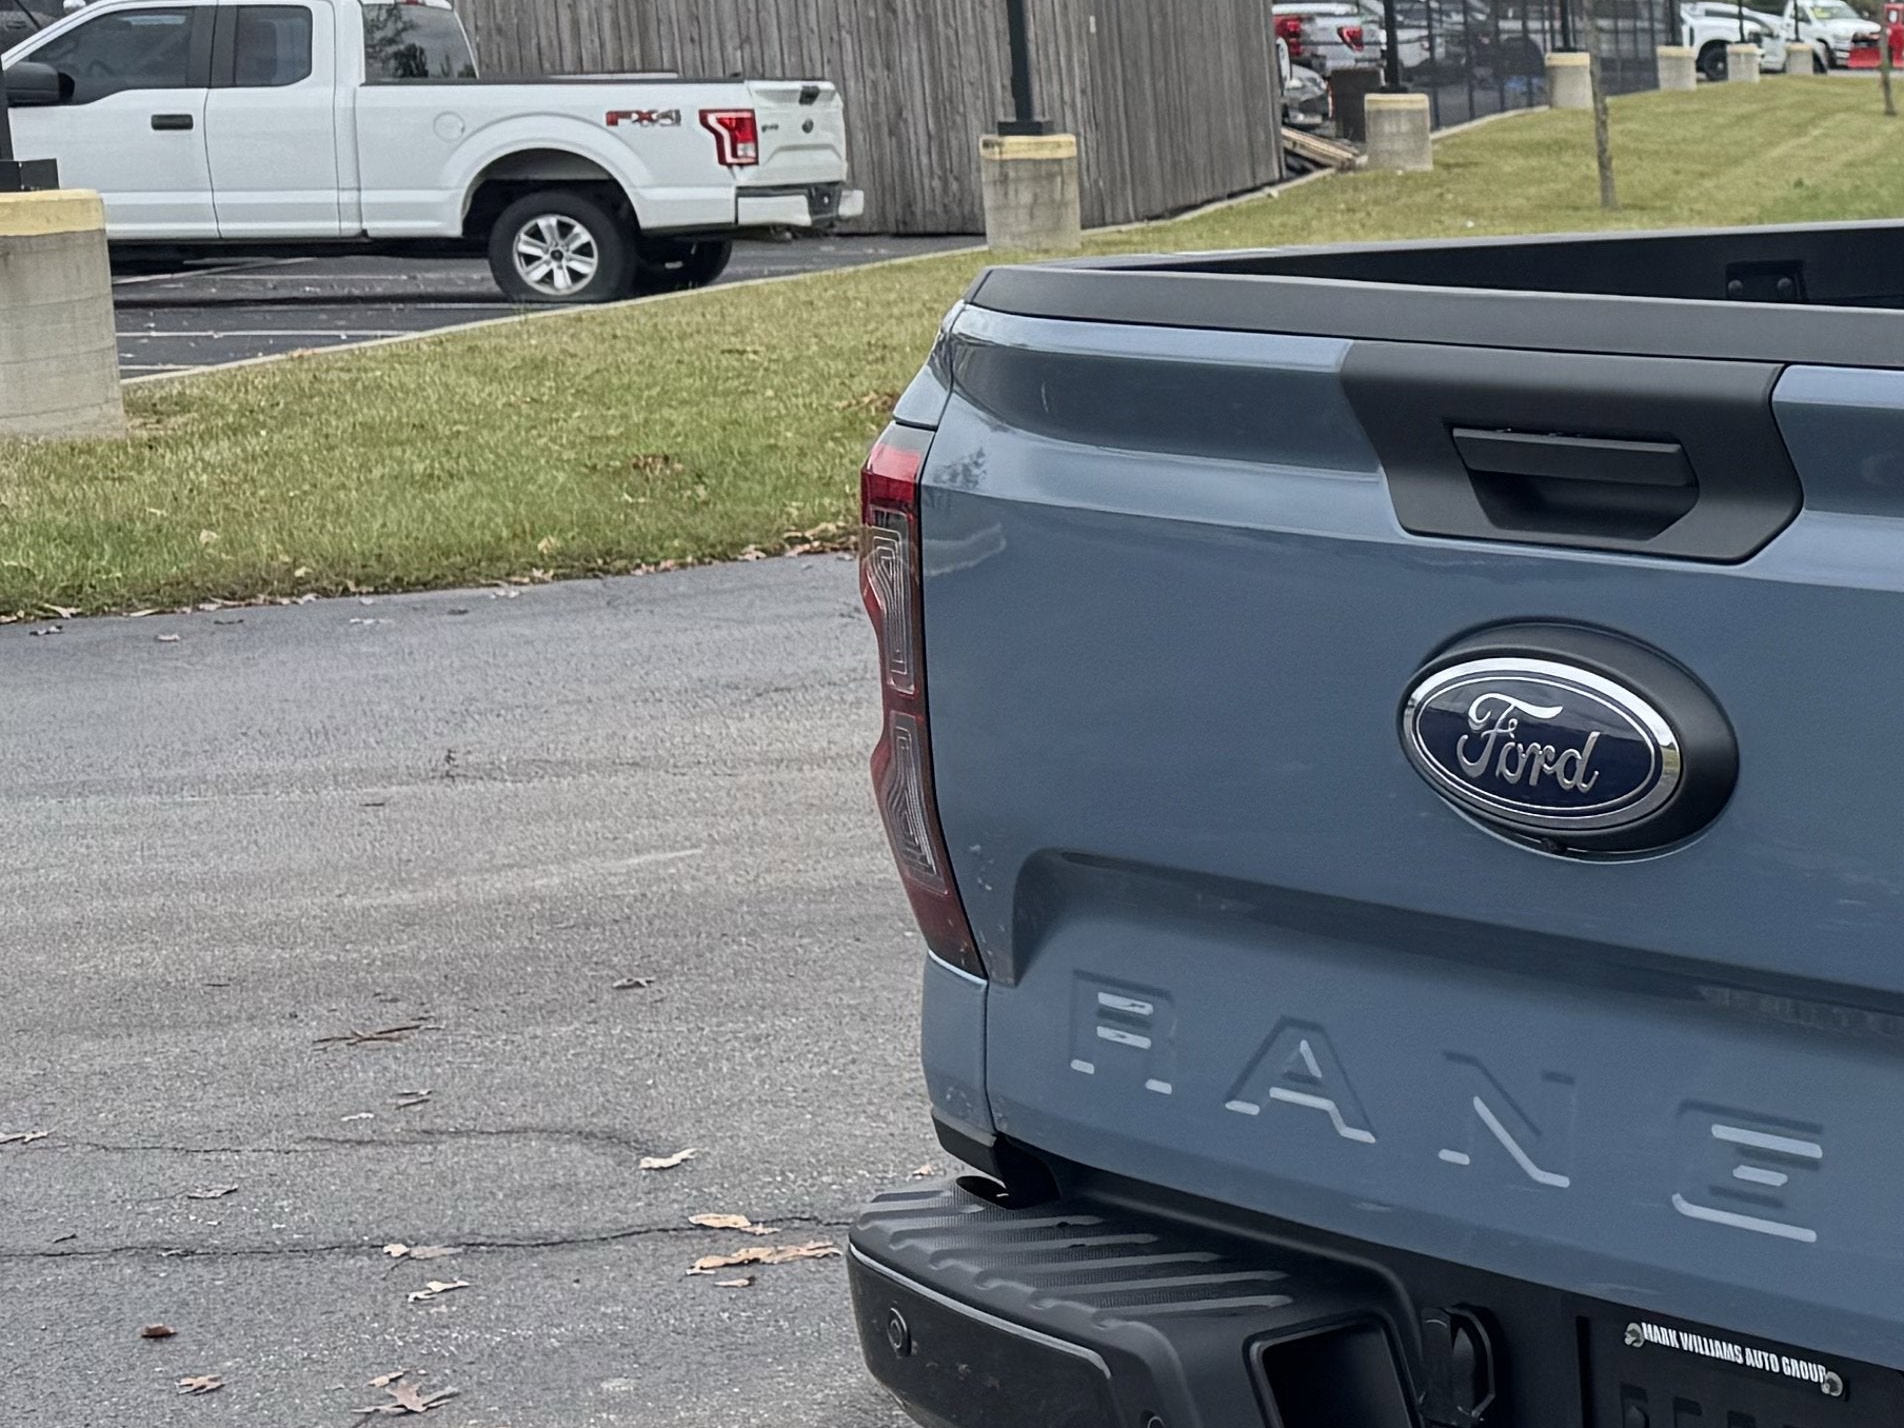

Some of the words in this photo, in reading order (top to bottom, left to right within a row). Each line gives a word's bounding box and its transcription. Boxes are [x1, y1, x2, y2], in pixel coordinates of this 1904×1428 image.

[605, 108, 683, 128] FX4
[1456, 691, 1601, 794] Ford
[1641, 1322, 1680, 1349] MARK
[1679, 1330, 1744, 1365] WILLIAMS
[1744, 1347, 1780, 1373] AUTO
[1781, 1355, 1827, 1384] GROUP
